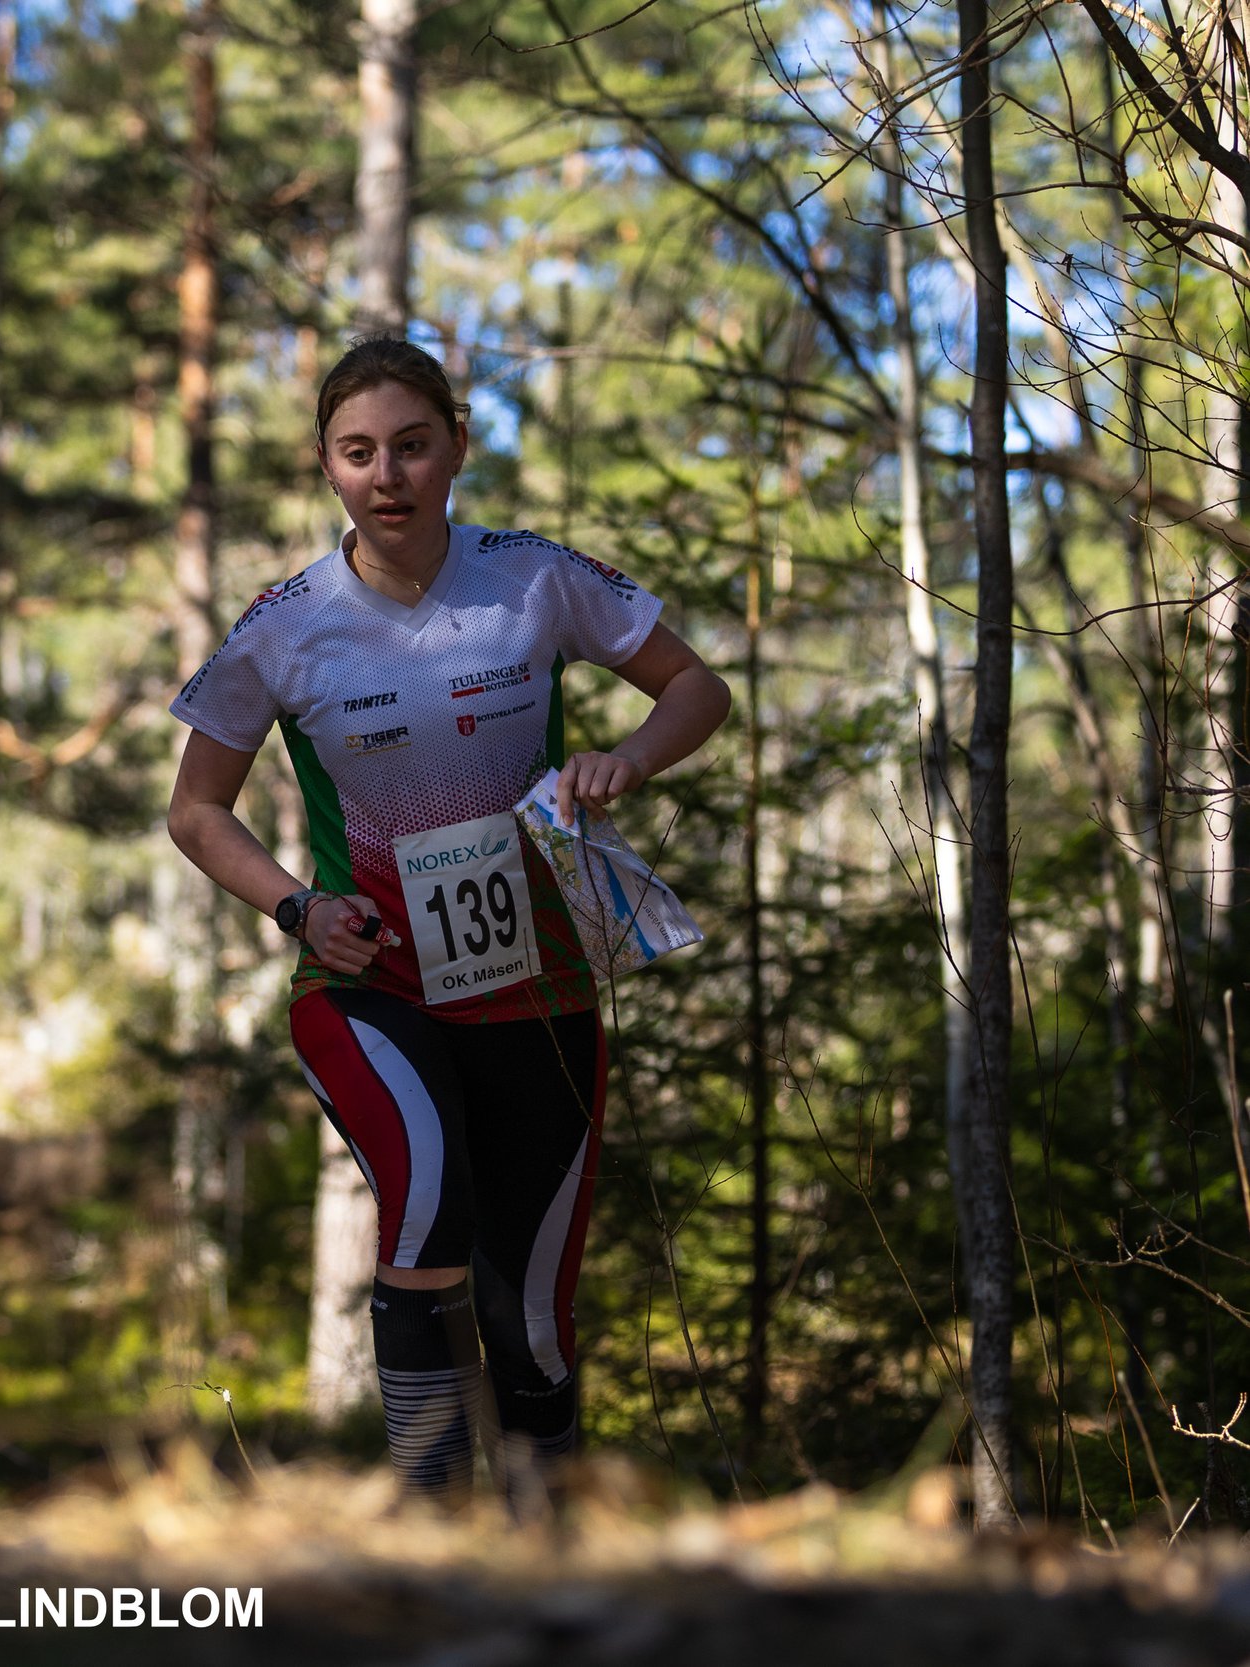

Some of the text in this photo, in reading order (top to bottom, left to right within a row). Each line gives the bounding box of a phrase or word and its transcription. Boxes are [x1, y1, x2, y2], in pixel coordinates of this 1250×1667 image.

[478, 540, 561, 554] MOUNTAIN
[448, 662, 530, 689] TULLINGE SK
[485, 676, 523, 692] BOTKYRKA
[343, 691, 398, 713] TRIMTEX
[476, 709, 511, 723] BOTKYRKA
[360, 726, 409, 744] TIGER
[406, 844, 479, 874] NOREX
[425, 871, 517, 962] 139
[442, 960, 523, 990] OK Måsen
